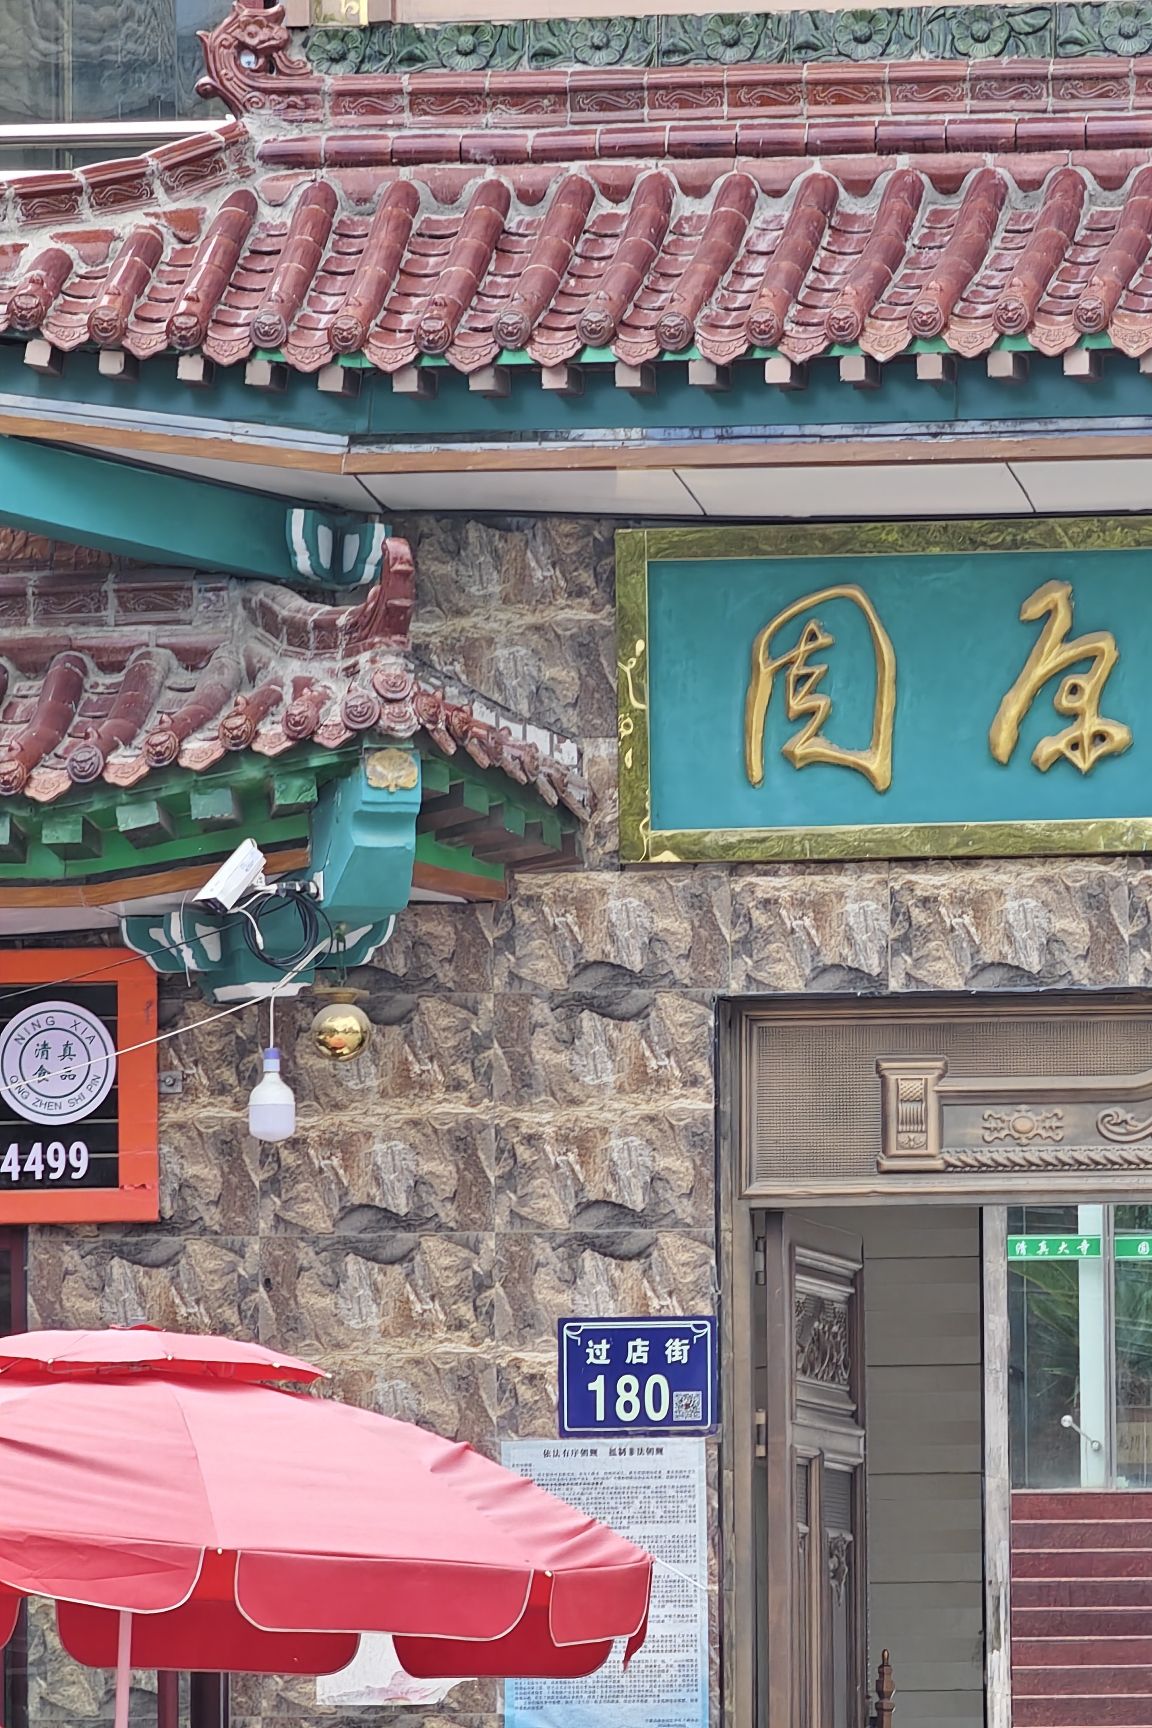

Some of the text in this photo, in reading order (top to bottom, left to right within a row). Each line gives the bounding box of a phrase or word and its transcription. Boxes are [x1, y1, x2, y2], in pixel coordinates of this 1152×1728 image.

[14, 1016, 97, 1045] NING XIA
[34, 1040, 77, 1062] 清真
[32, 1064, 77, 1084] 食品
[32, 1097, 63, 1111] ZHEN
[68, 1092, 87, 1108] SHI
[86, 1074, 102, 1094] PIN
[0, 1140, 89, 1182] 4499
[1015, 1240, 1091, 1256] 清真大寺
[585, 1337, 691, 1365] 过店街
[587, 1373, 670, 1422] 180
